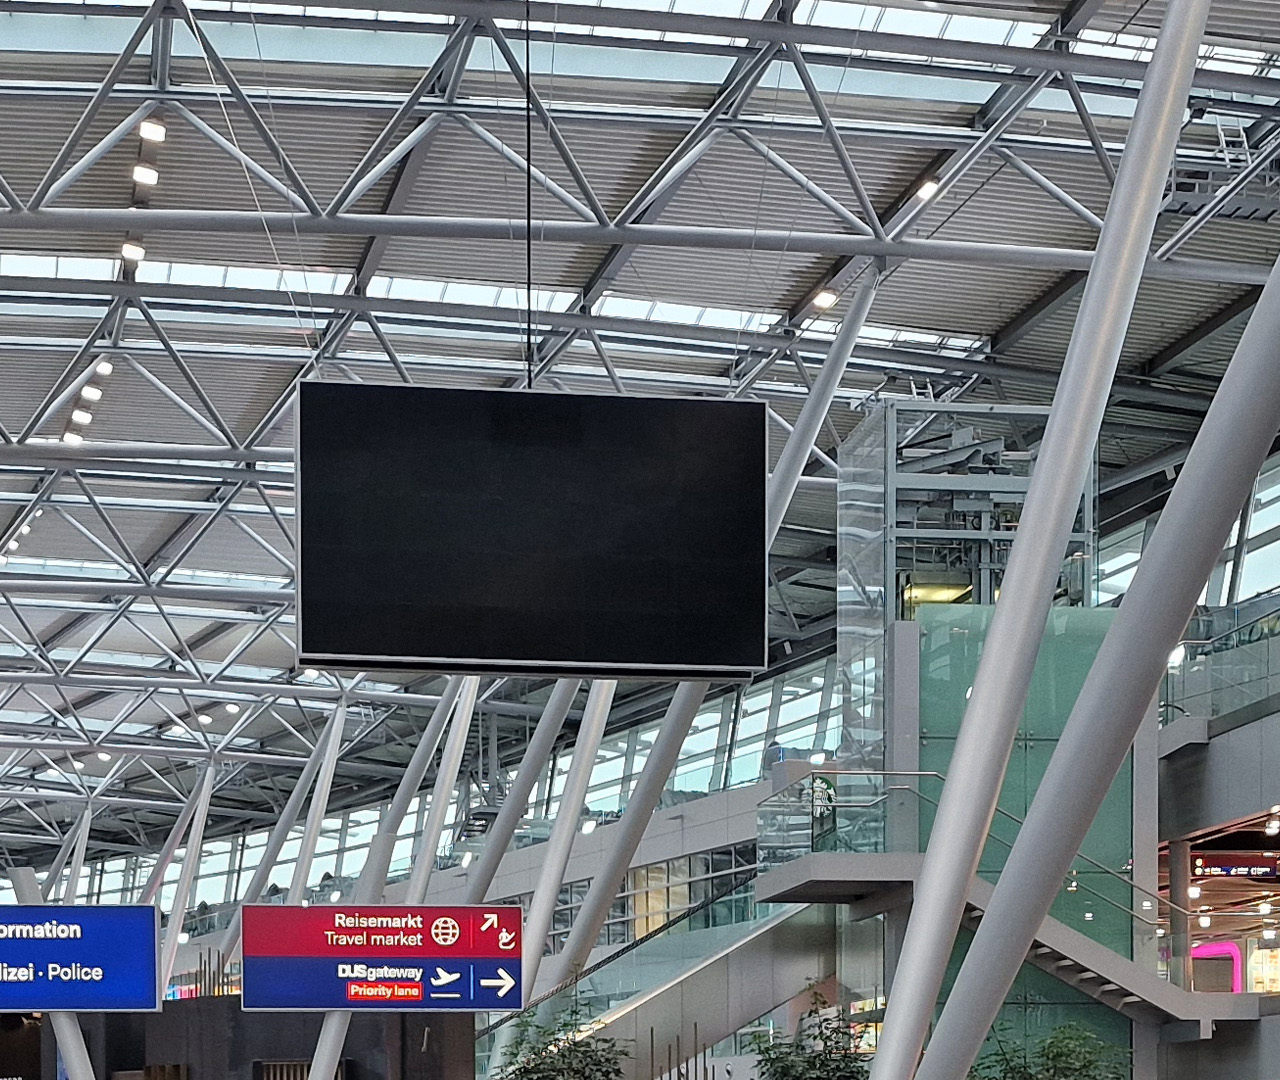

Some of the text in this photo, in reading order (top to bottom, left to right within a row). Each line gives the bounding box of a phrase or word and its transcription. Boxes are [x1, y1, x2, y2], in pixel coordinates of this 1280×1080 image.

[335, 913, 423, 928] Reisemarkt
[324, 931, 423, 946] Travel market
[47, 963, 104, 981] Police
[350, 985, 419, 998] Priority lane
